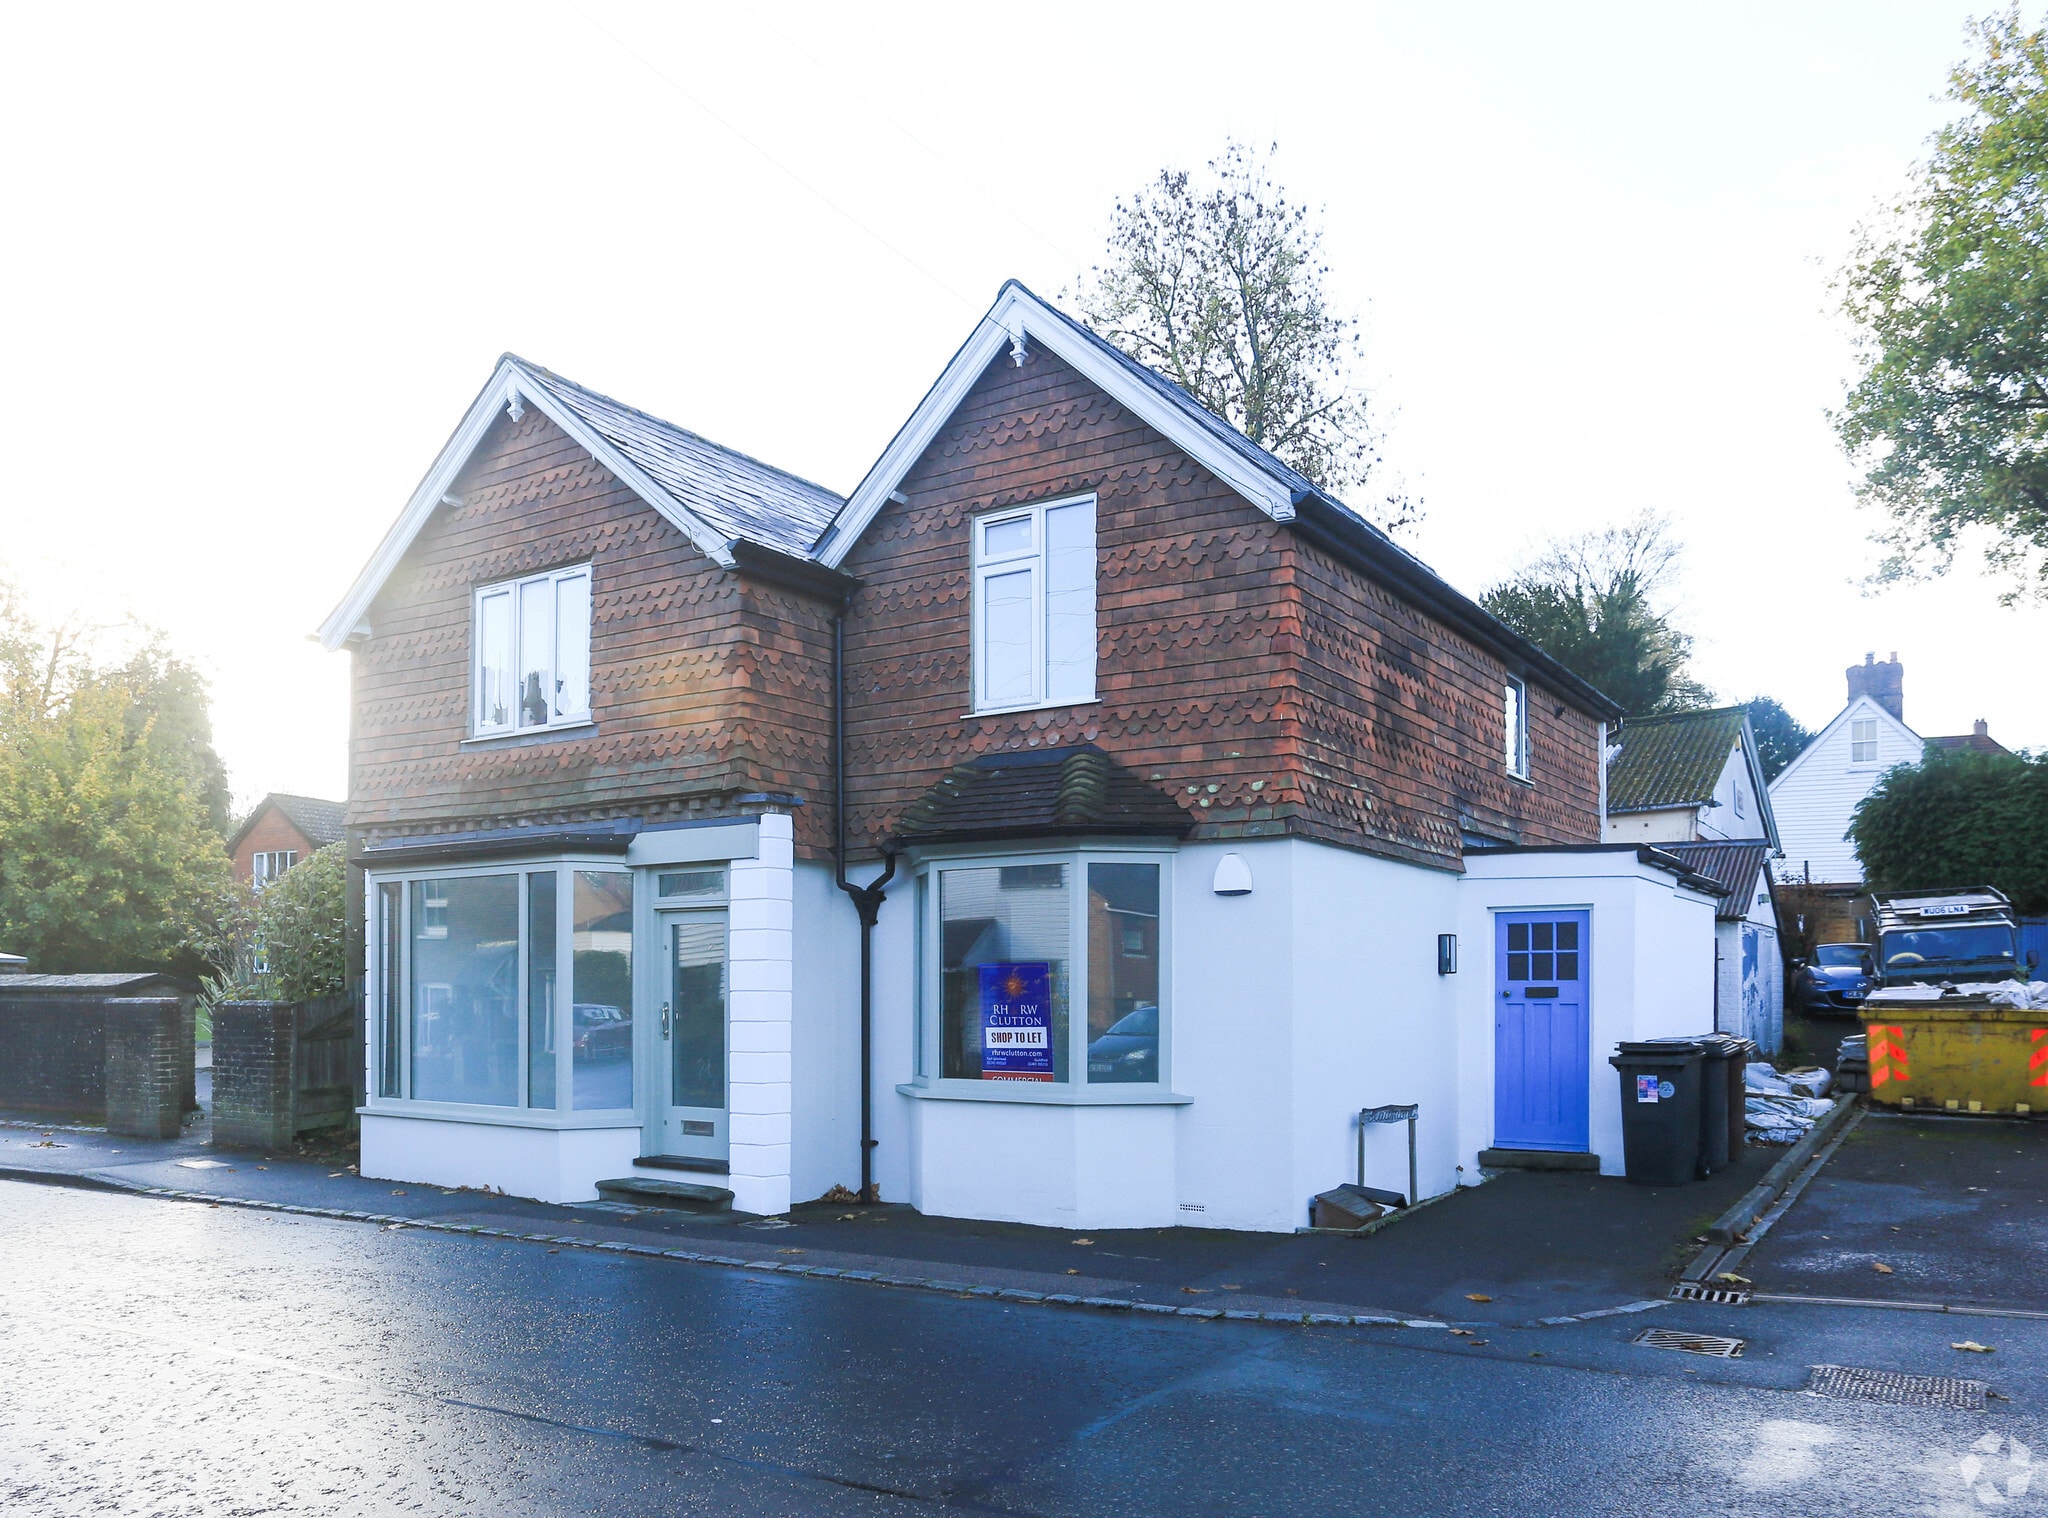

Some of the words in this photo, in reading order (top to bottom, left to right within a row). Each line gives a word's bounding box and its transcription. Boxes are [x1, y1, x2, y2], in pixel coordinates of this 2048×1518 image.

[993, 1004, 1008, 1015] RH
[1020, 1004, 1038, 1015] RW
[991, 1032, 1012, 1043] SHOP
[1014, 1032, 1025, 1043] TO
[1027, 1032, 1042, 1044] LET
[991, 1049, 1043, 1057] rhrwclutton.com
